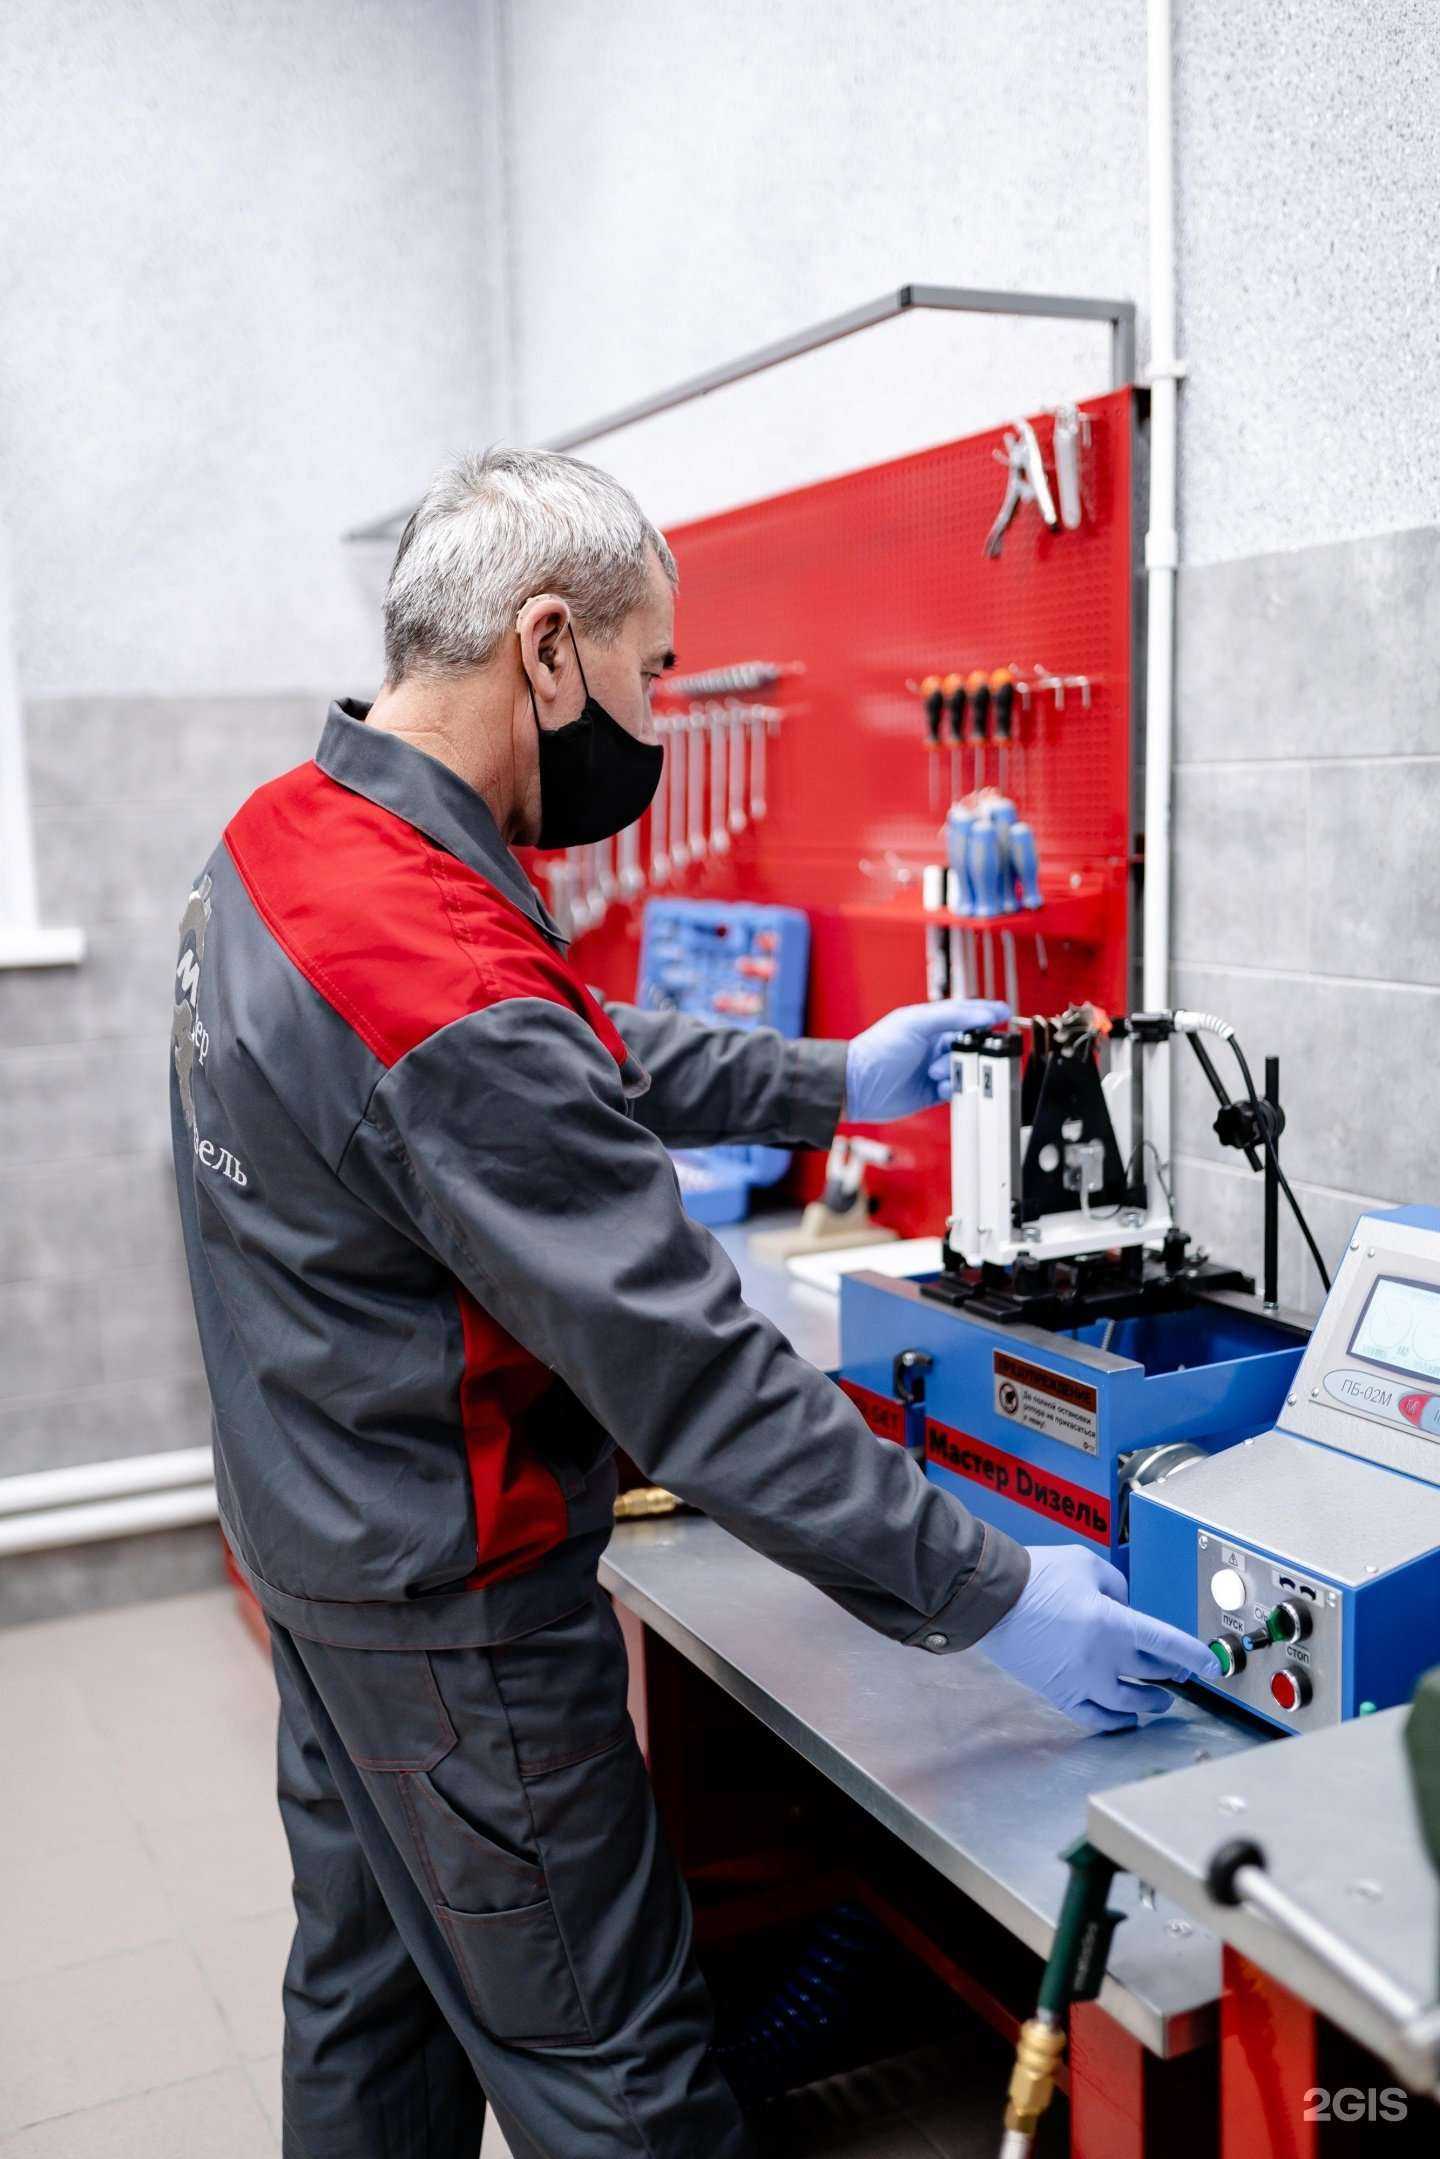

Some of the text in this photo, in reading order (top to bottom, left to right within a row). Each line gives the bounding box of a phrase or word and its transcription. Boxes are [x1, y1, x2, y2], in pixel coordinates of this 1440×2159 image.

[984, 1072, 990, 1089] 2
[1341, 1378, 1393, 1407] ПБ-02М
[928, 1427, 1108, 1533] Мастер Dизель
